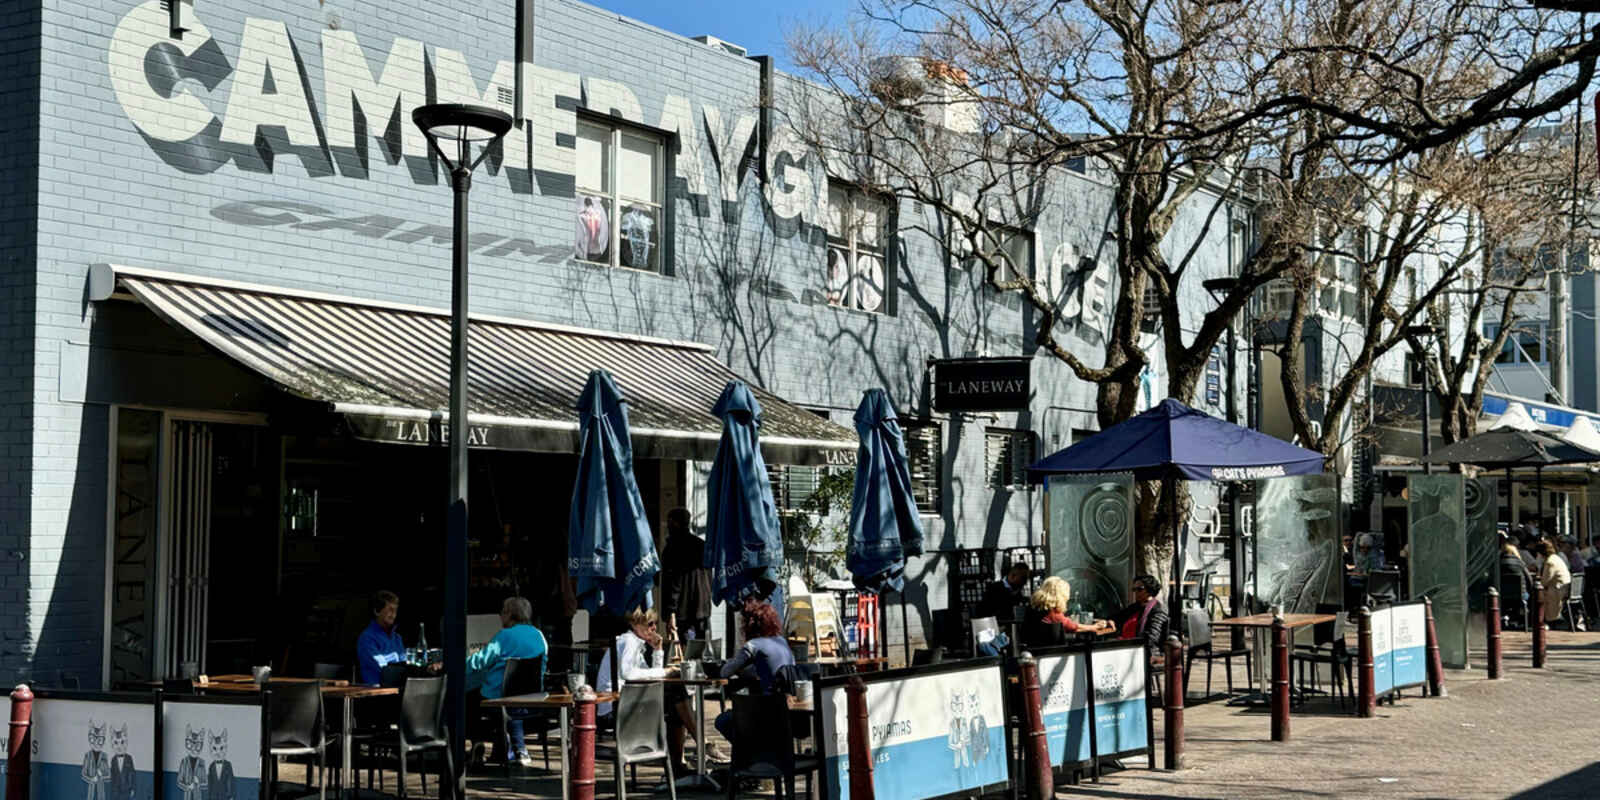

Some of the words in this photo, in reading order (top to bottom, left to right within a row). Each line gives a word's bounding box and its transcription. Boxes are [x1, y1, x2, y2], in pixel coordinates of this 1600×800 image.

[948, 379, 1025, 394] LANEWAY
[397, 421, 489, 446] LANEAY
[872, 719, 912, 742] PYJAMAS
